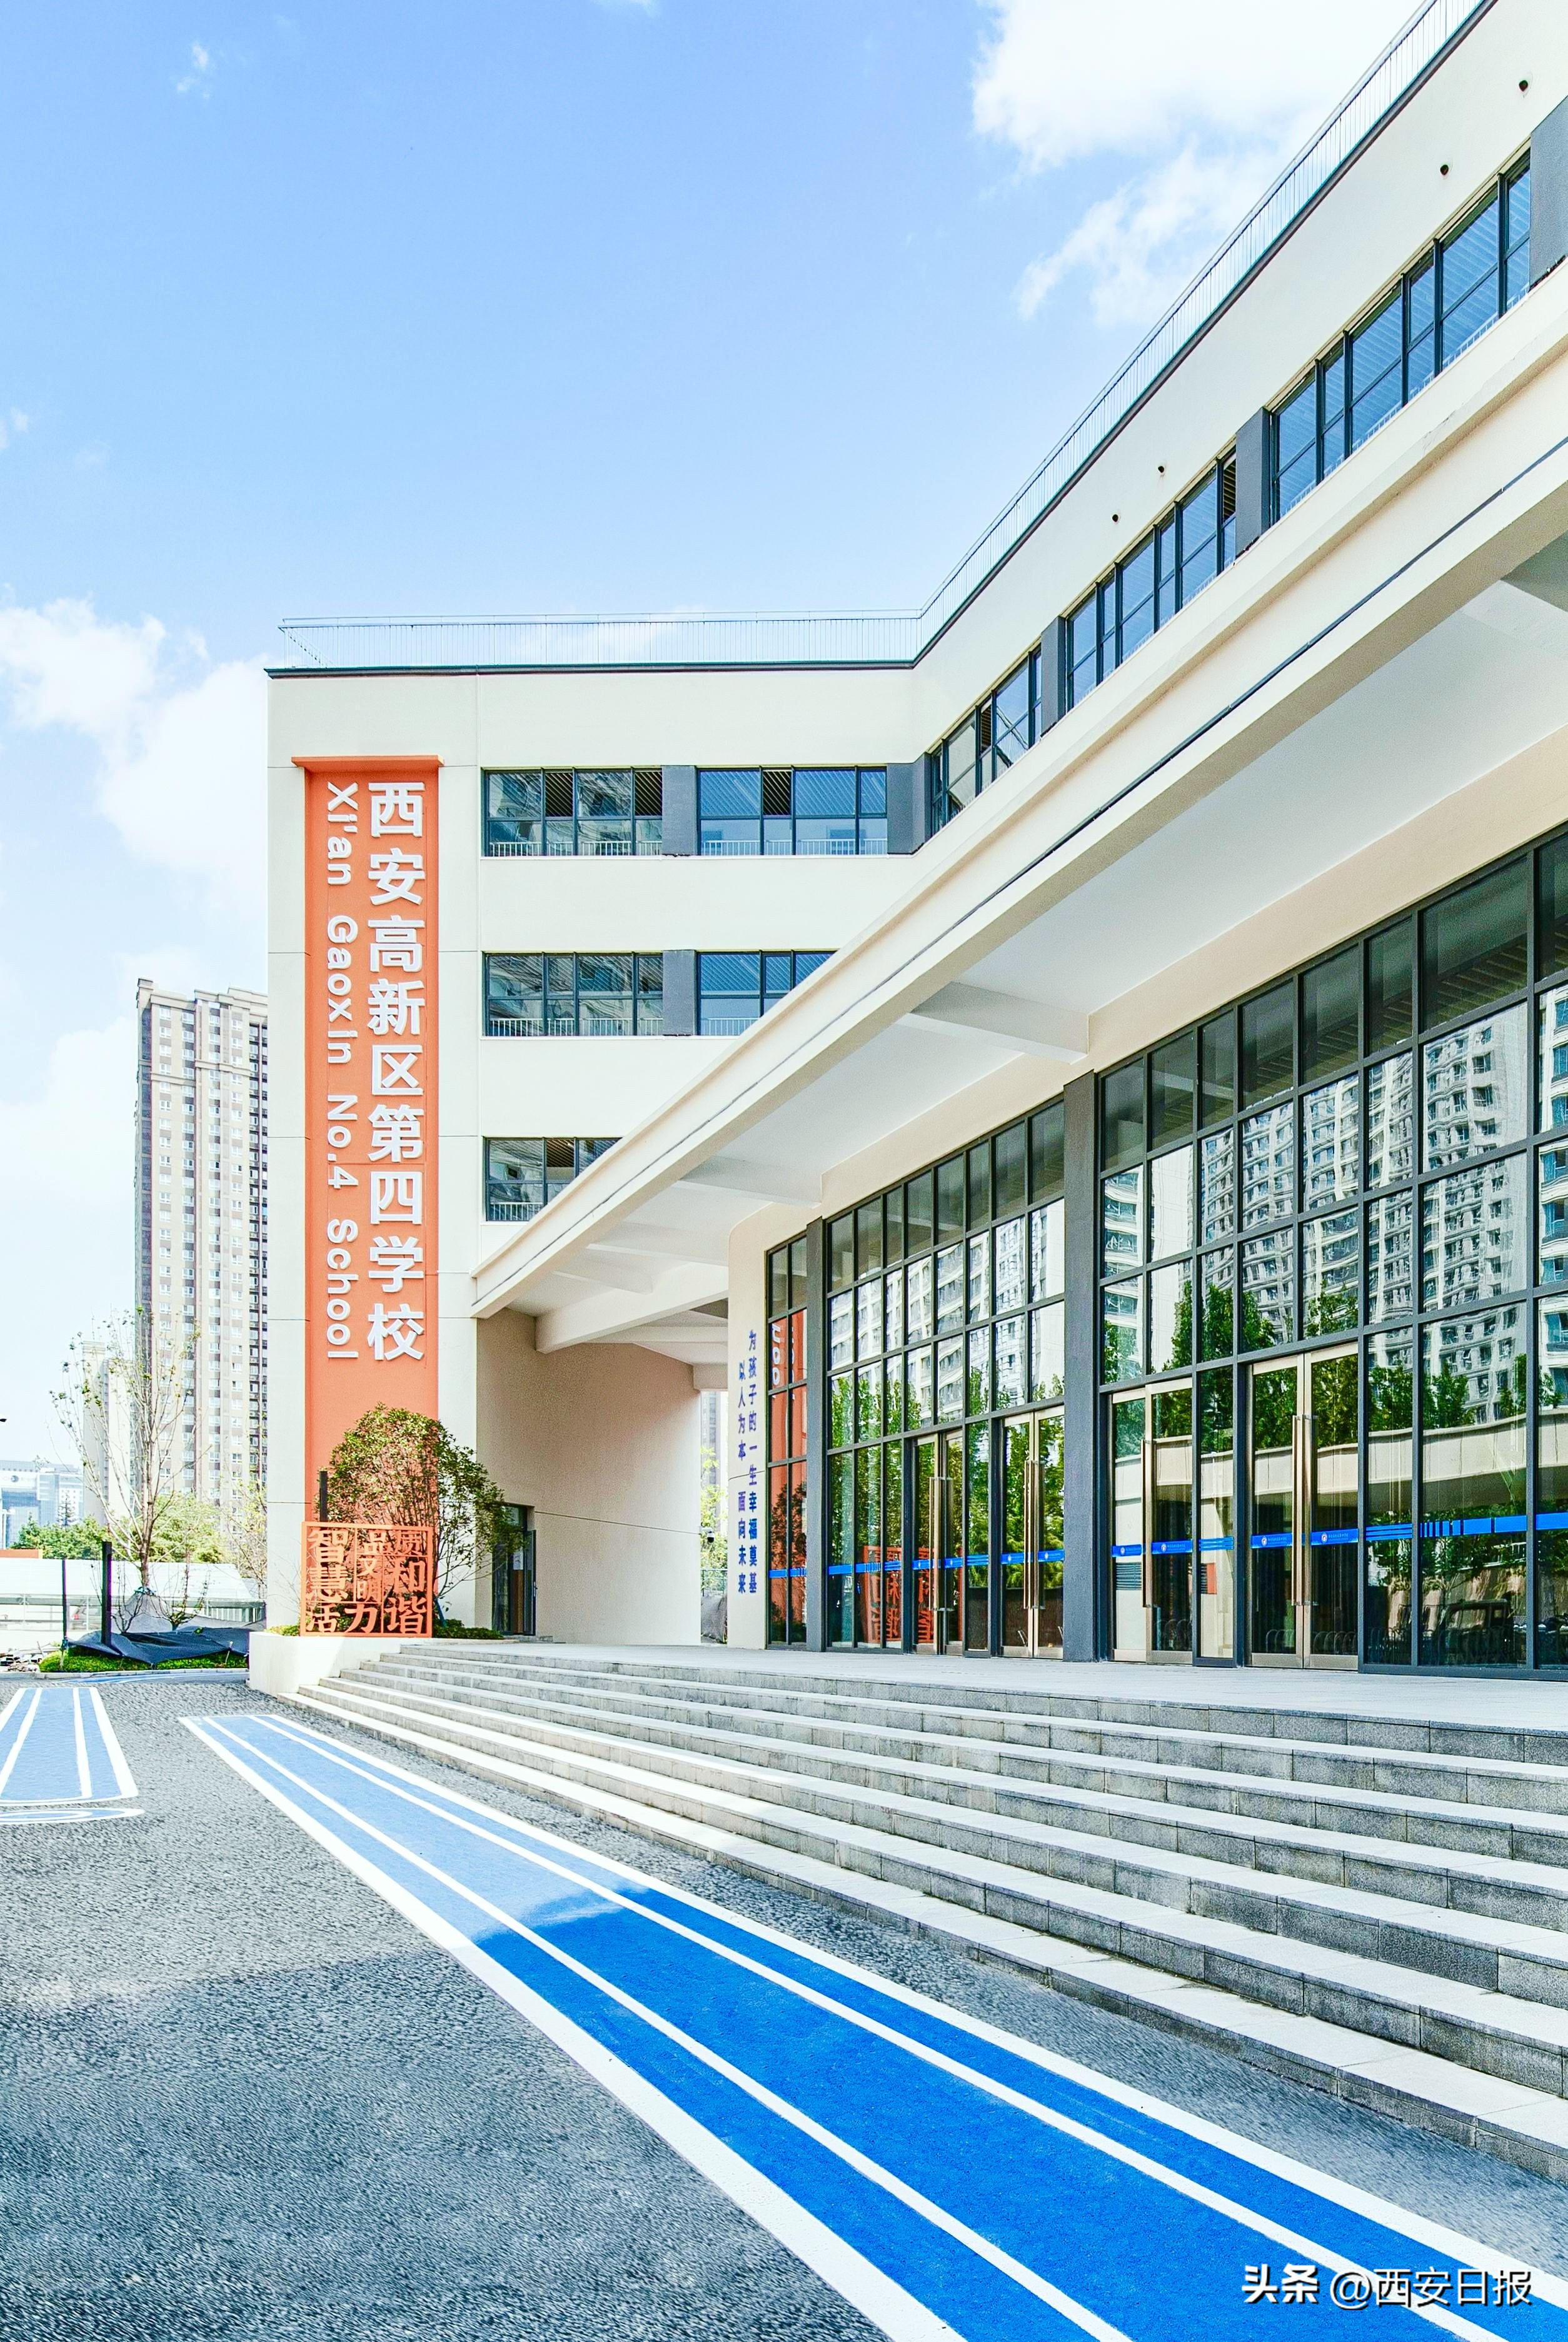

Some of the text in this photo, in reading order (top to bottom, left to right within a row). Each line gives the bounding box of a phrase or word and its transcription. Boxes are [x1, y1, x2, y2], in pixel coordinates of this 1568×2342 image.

[326, 782, 358, 1359] Xi'an Gaoxin No.4 School
[368, 782, 425, 1360] 西安高新区第四学校
[738, 1360, 746, 1594] 以人为本 面向未来
[748, 1329, 758, 1594] 为孩子的一生幸福奠基
[306, 1527, 350, 1602] 智慧
[306, 1603, 378, 1633] 活力
[356, 1554, 381, 1602] 文明
[384, 1556, 428, 1634] 和谐
